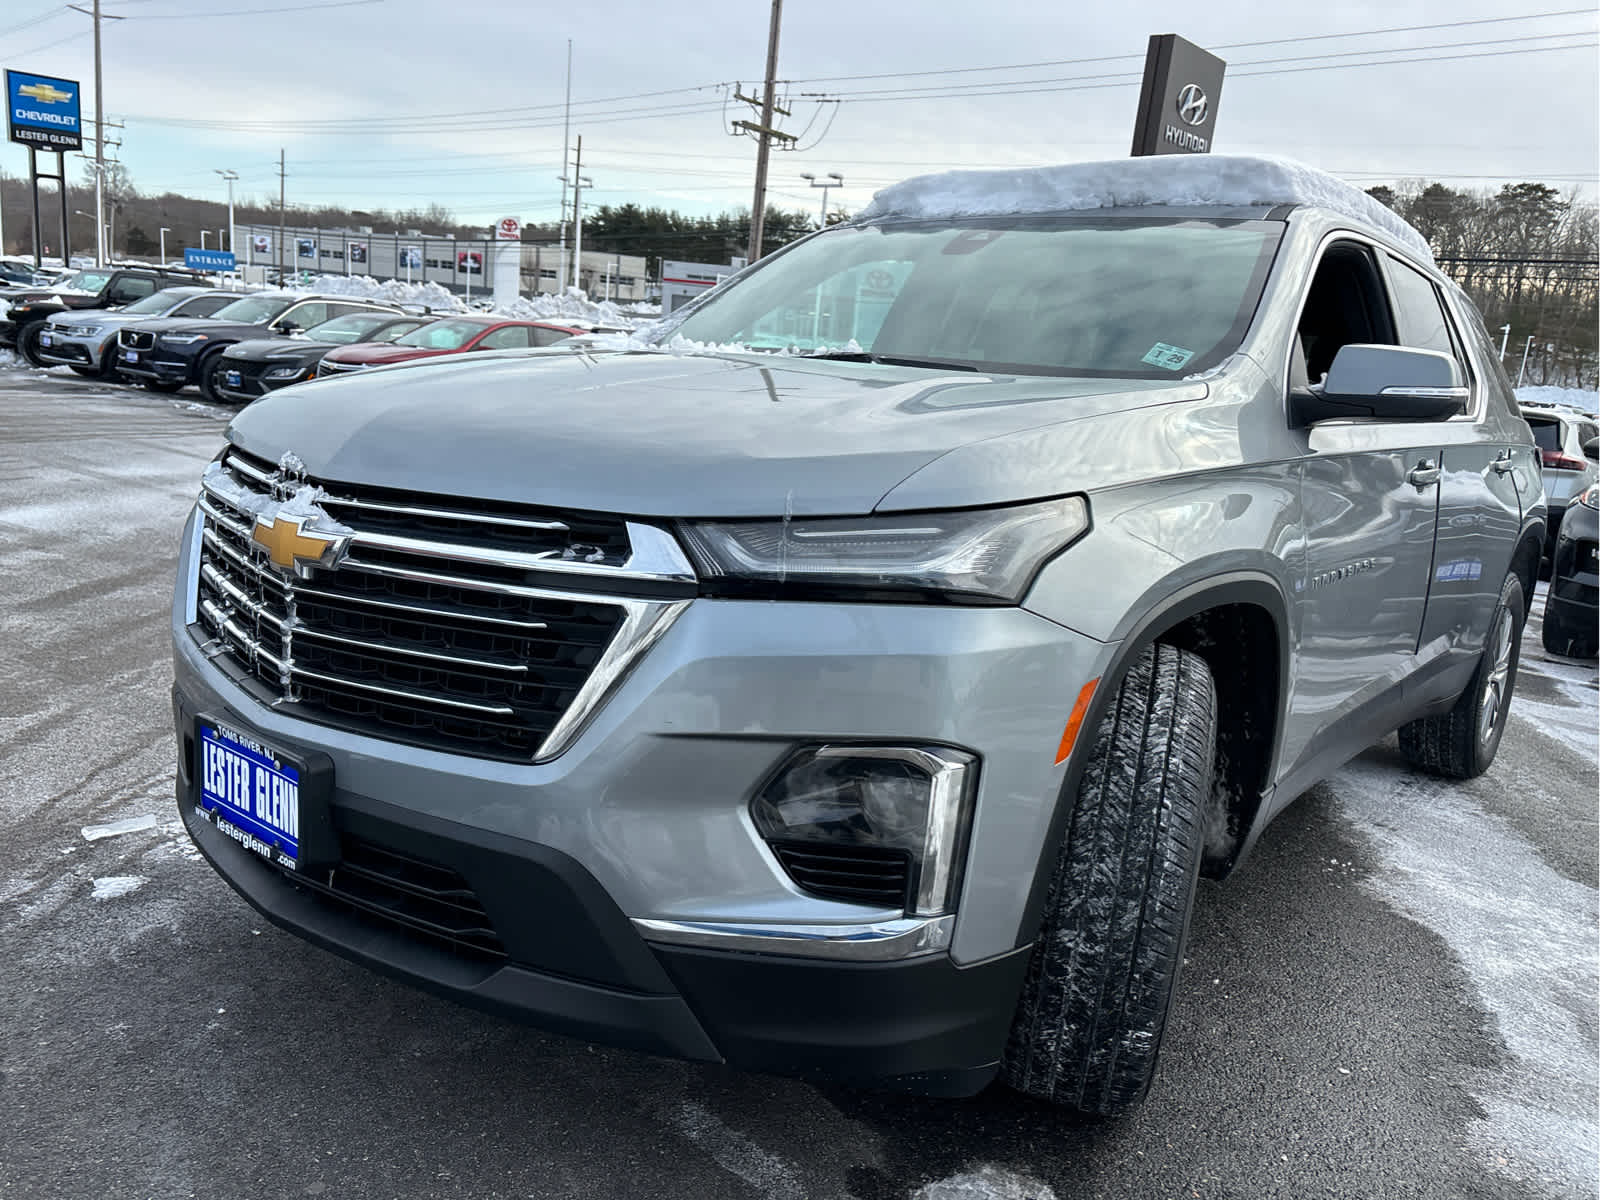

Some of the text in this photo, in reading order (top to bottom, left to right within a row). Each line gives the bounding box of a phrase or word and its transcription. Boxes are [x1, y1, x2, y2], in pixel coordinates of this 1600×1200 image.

[15, 109, 76, 126] CHEVROLET
[15, 129, 79, 145] LESTER GLENN
[1165, 125, 1209, 153] HYUNDAI
[189, 254, 233, 266] ENTRANCE
[217, 724, 239, 744] TOMS
[264, 747, 275, 761] NJ
[203, 741, 299, 839] LESTER GLENN
